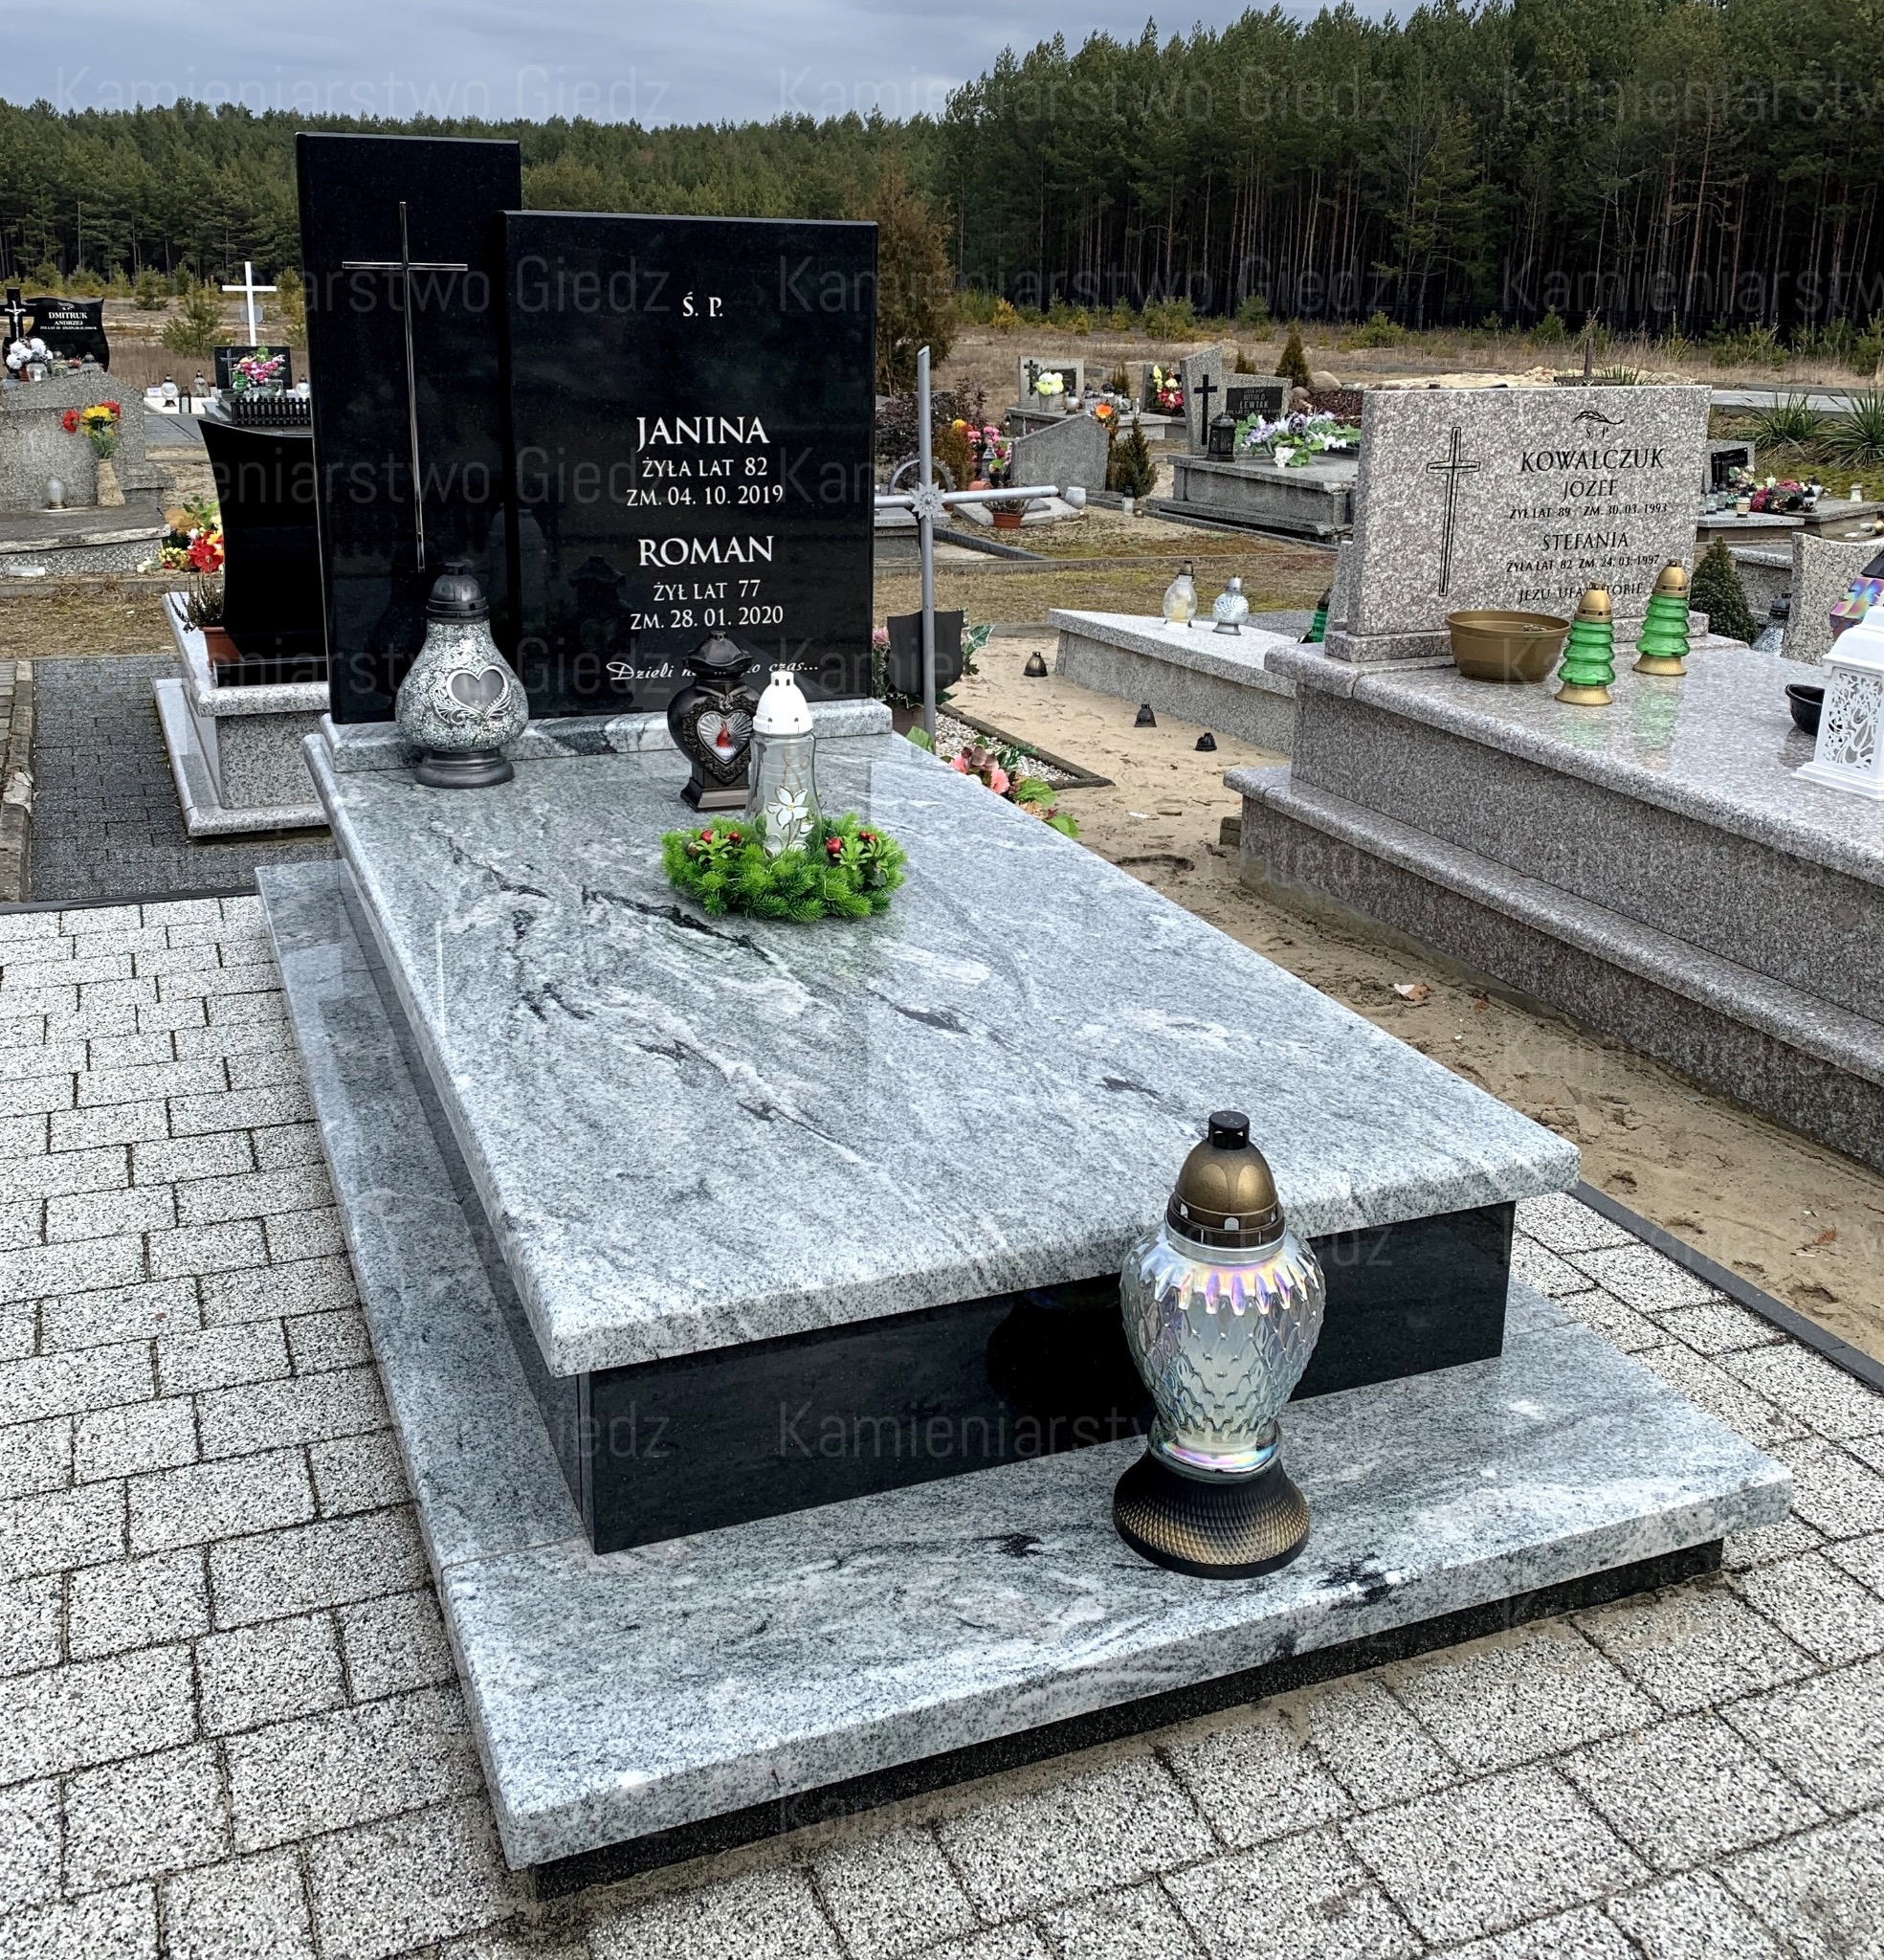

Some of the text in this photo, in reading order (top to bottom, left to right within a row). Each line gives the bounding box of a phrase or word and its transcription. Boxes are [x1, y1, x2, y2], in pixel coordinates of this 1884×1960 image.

[682, 291, 723, 317] Ś. P.
[636, 416, 771, 453] JANINA
[642, 457, 767, 478] ŻYŁA LAT 82
[1521, 448, 1664, 472] KOWALCZUK
[626, 484, 784, 506] ZM. 04. 10. 2019
[1533, 507, 1552, 519] LAT
[1558, 506, 1571, 518] 89
[1584, 505, 1603, 517] ZM.
[1607, 504, 1622, 516] 30.
[1644, 502, 1667, 514] 1993
[637, 535, 774, 568] ROMAN
[1541, 531, 1629, 552] STEFANIA
[1537, 560, 1554, 571] LAT
[1560, 559, 1572, 569] 82
[1637, 554, 1659, 566] 1997
[653, 579, 761, 602] ŻYŁ LAT 77
[1519, 589, 1551, 604] JEZU
[630, 605, 784, 631] ZM. 28. 01. 2020
[606, 661, 675, 680] Dzieli
